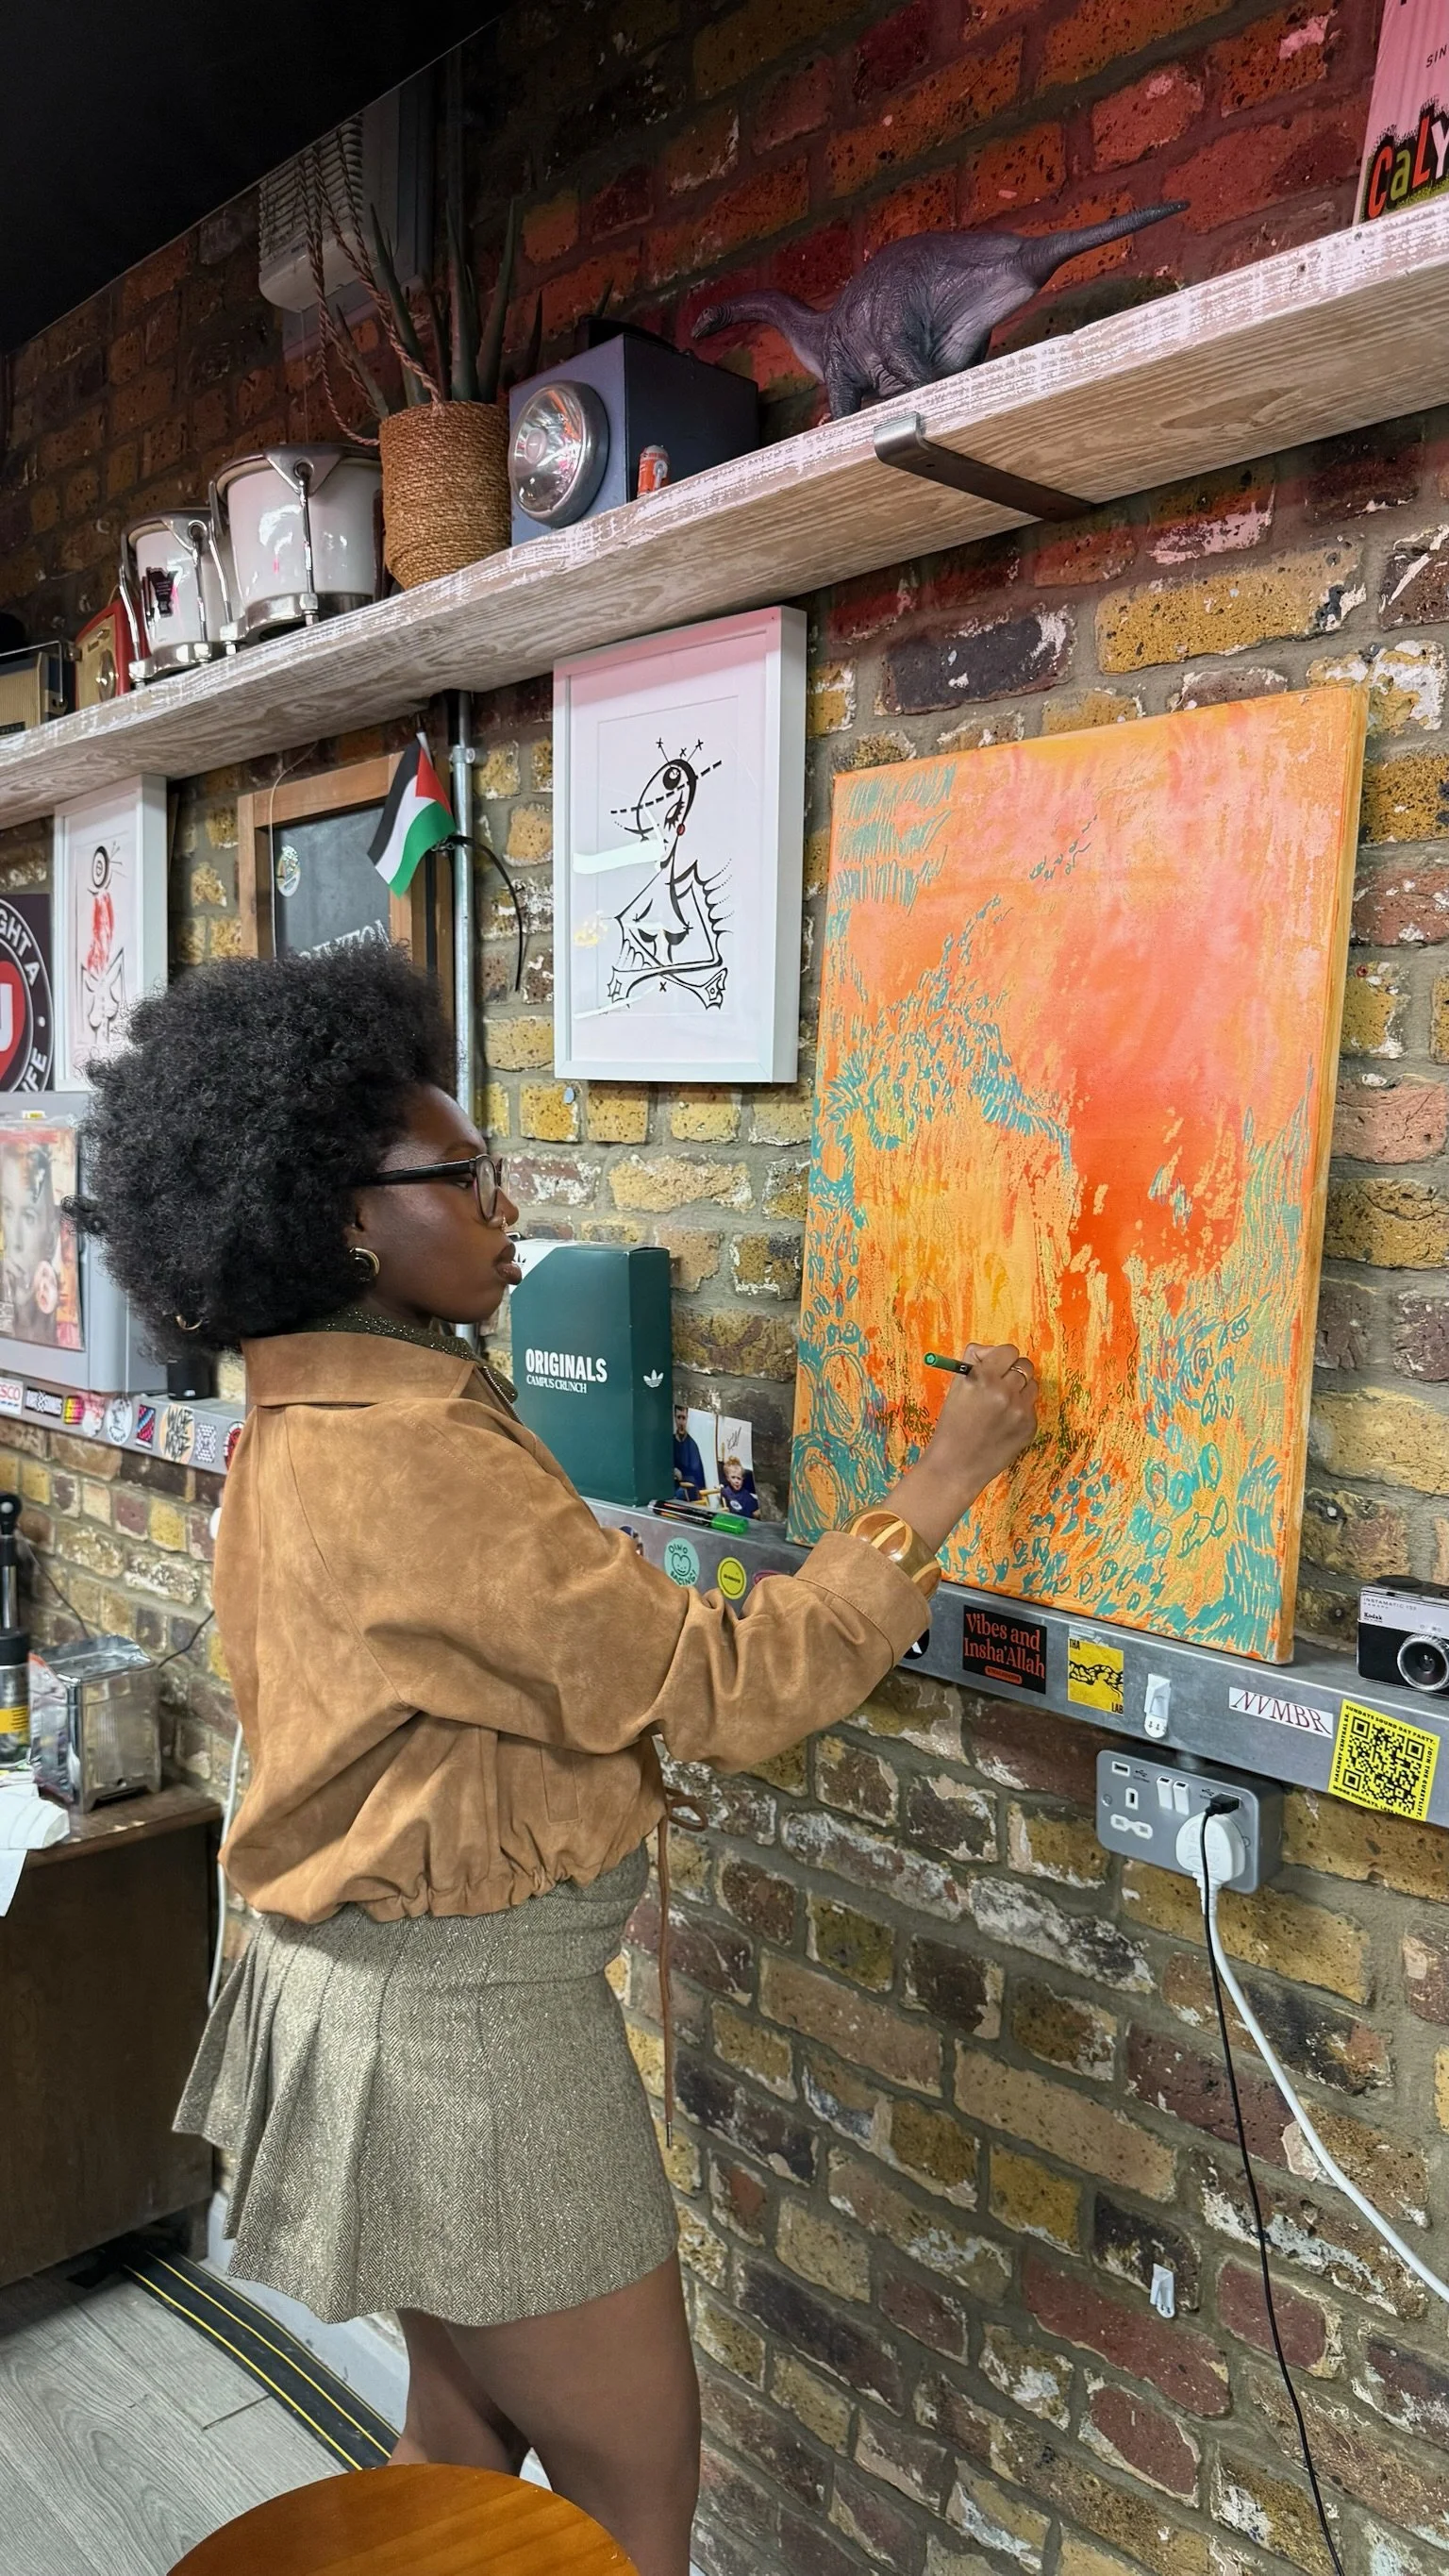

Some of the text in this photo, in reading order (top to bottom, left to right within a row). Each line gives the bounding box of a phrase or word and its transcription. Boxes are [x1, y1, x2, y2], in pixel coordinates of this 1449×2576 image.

[24, 961, 41, 987] A
[525, 1347, 608, 1383] ORIGINALS
[525, 1374, 588, 1395] CAMPUS CRUNCH
[668, 1543, 689, 1554] DINO
[1363, 1612, 1382, 1620] Kodak
[965, 1613, 1041, 1651] Vibes and
[1069, 1638, 1080, 1650] THA
[963, 1637, 1045, 1680] Insha'Allah
[1111, 1701, 1124, 1715] LAB
[1230, 1691, 1332, 1735] NVMBR
[1375, 1716, 1397, 1730] SOUND
[1398, 1725, 1412, 1735] DAY
[1335, 1752, 1343, 1782] HACKNEY
[1340, 1723, 1348, 1751] CENTRAL
